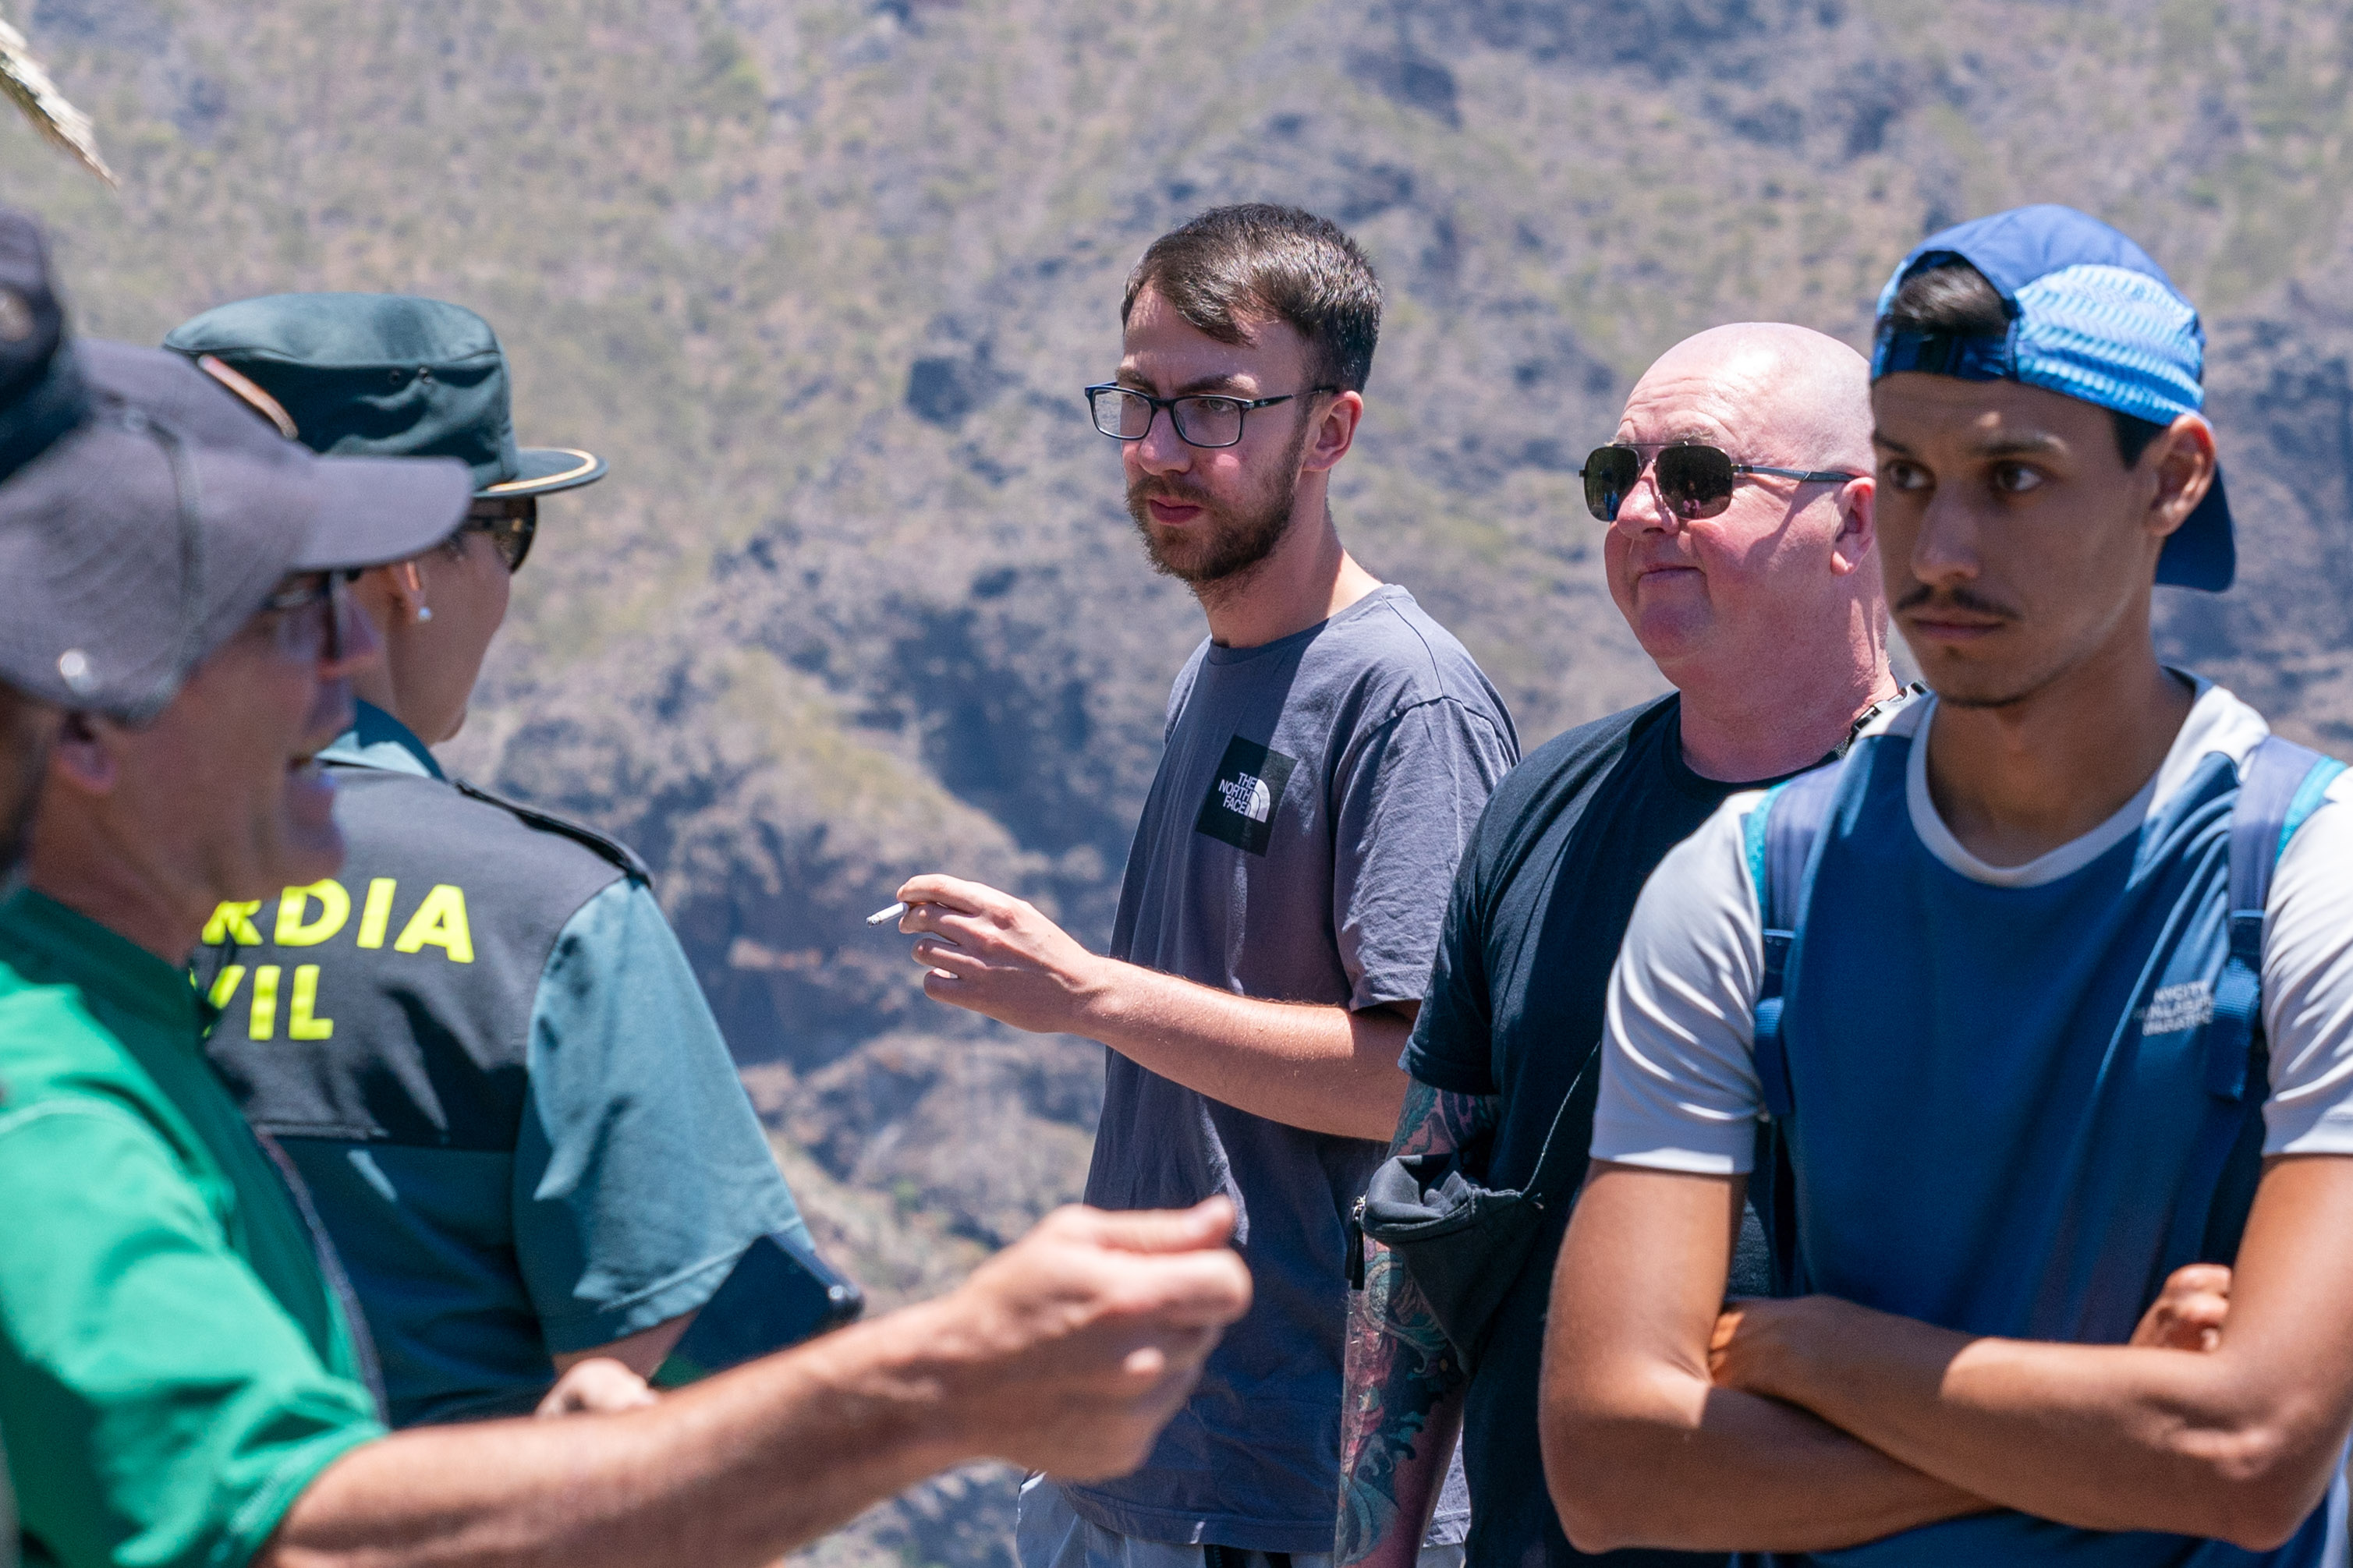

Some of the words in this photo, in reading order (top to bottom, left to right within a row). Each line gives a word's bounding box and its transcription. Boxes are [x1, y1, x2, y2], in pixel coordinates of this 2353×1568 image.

[1218, 779, 1253, 802] NORTH
[1239, 772, 1258, 790] THE
[1223, 795, 1248, 816] FACE
